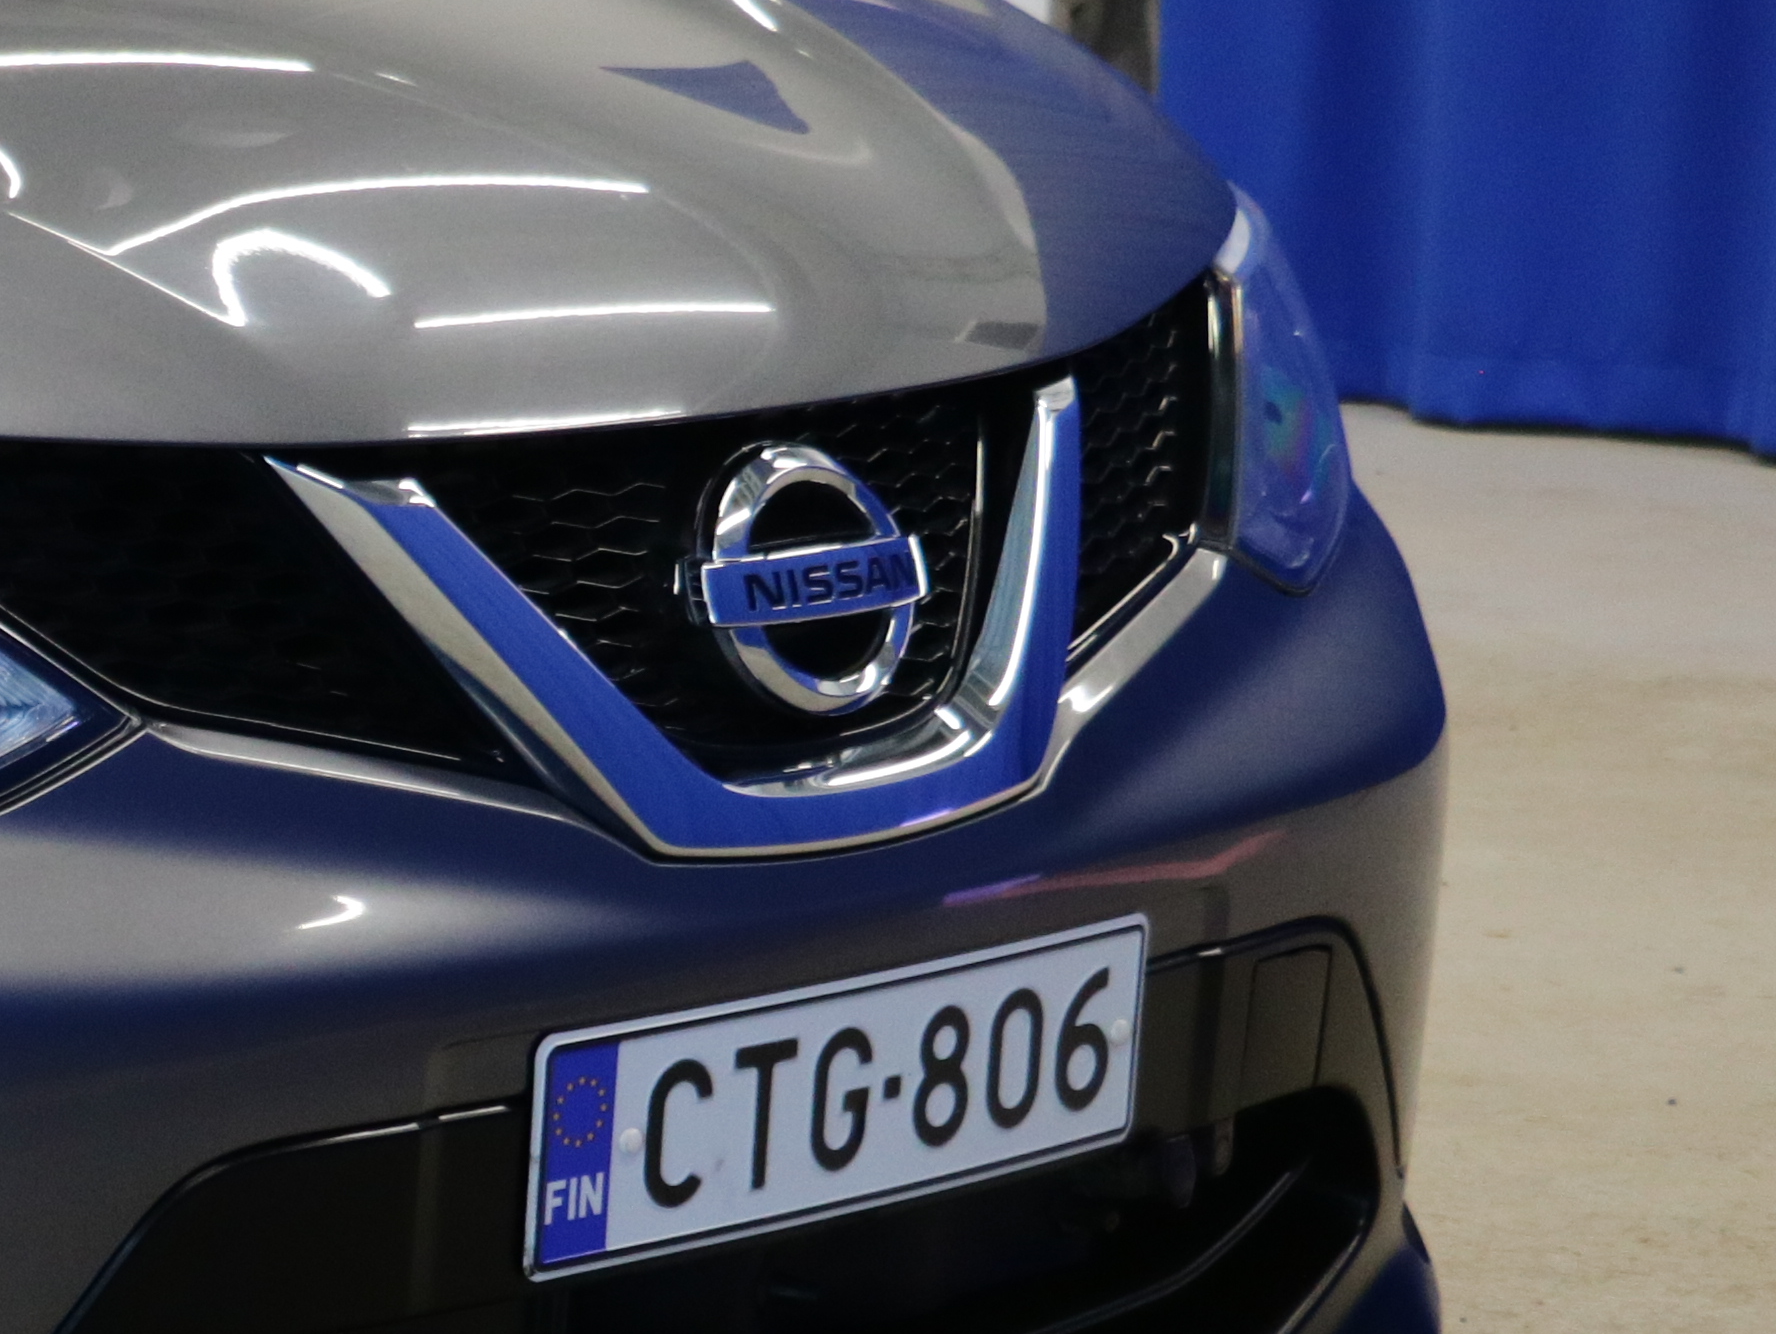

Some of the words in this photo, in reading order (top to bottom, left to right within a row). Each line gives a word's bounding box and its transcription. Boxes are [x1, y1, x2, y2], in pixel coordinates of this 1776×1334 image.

[743, 552, 918, 612] NISSAN
[642, 966, 1111, 1208] CTG-806
[542, 1171, 605, 1227] FIN
